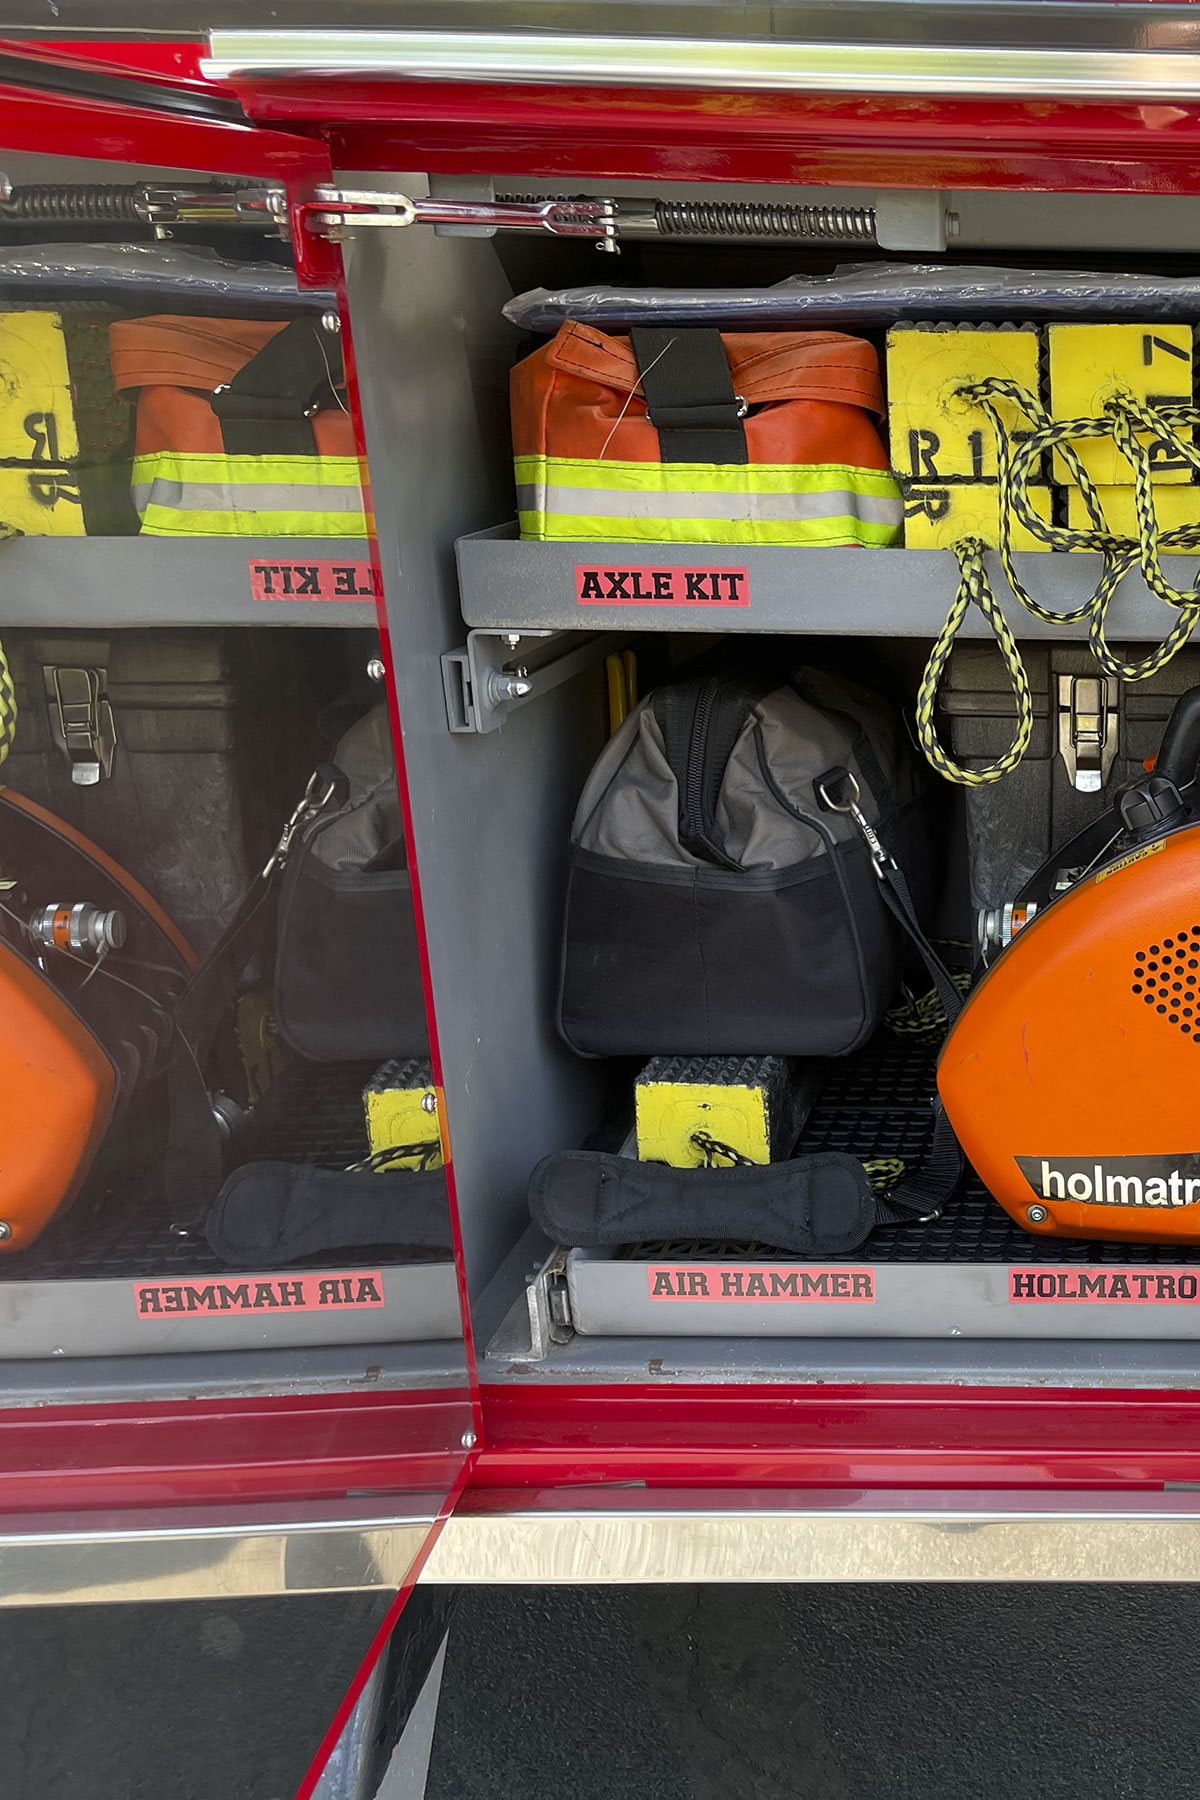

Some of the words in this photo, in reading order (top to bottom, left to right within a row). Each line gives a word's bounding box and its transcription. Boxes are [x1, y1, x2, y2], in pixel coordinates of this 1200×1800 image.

[580, 571, 674, 599] AXLE
[684, 573, 744, 600] KIT
[652, 1272, 710, 1296] AIR
[720, 1273, 873, 1298] HAMMER
[1012, 1274, 1198, 1299] HOLMATRO
